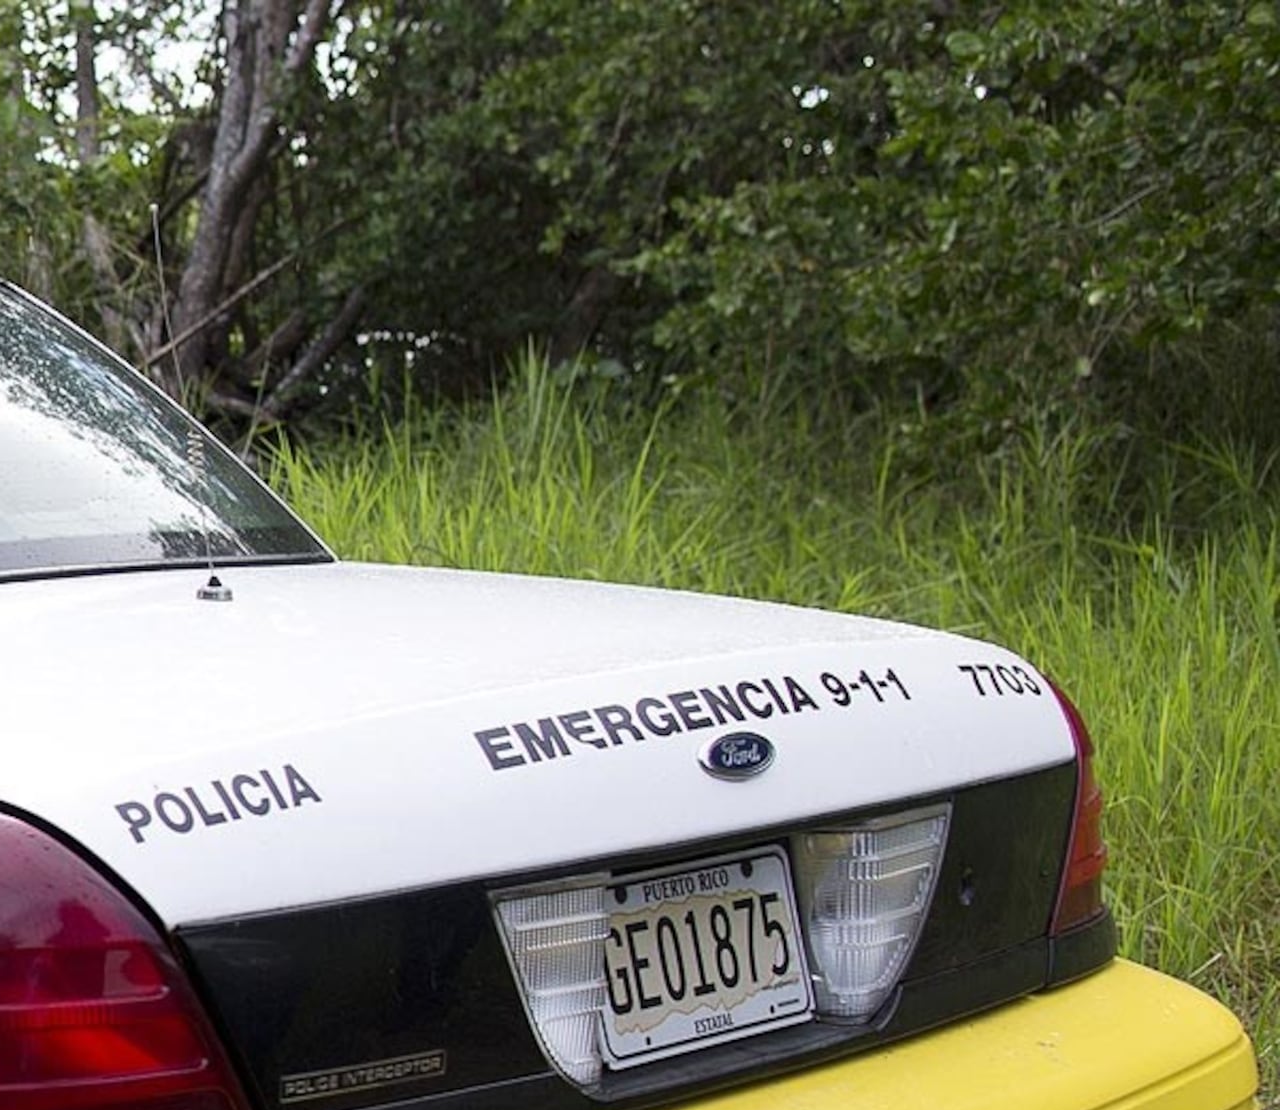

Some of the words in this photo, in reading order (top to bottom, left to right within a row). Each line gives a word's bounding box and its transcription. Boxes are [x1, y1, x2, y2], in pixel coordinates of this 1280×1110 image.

[958, 664, 1042, 697] 7703
[473, 675, 819, 771] EMERGENCIA
[819, 667, 911, 707] 9-1-1
[720, 738, 761, 768] Ford
[115, 764, 322, 844] POLICIA
[642, 874, 696, 903] PUERTO
[698, 869, 730, 891] RICO
[693, 1013, 735, 1035] ESTATAL
[284, 1074, 339, 1097] POLICE
[342, 1056, 441, 1087] INTERCEPTOR
